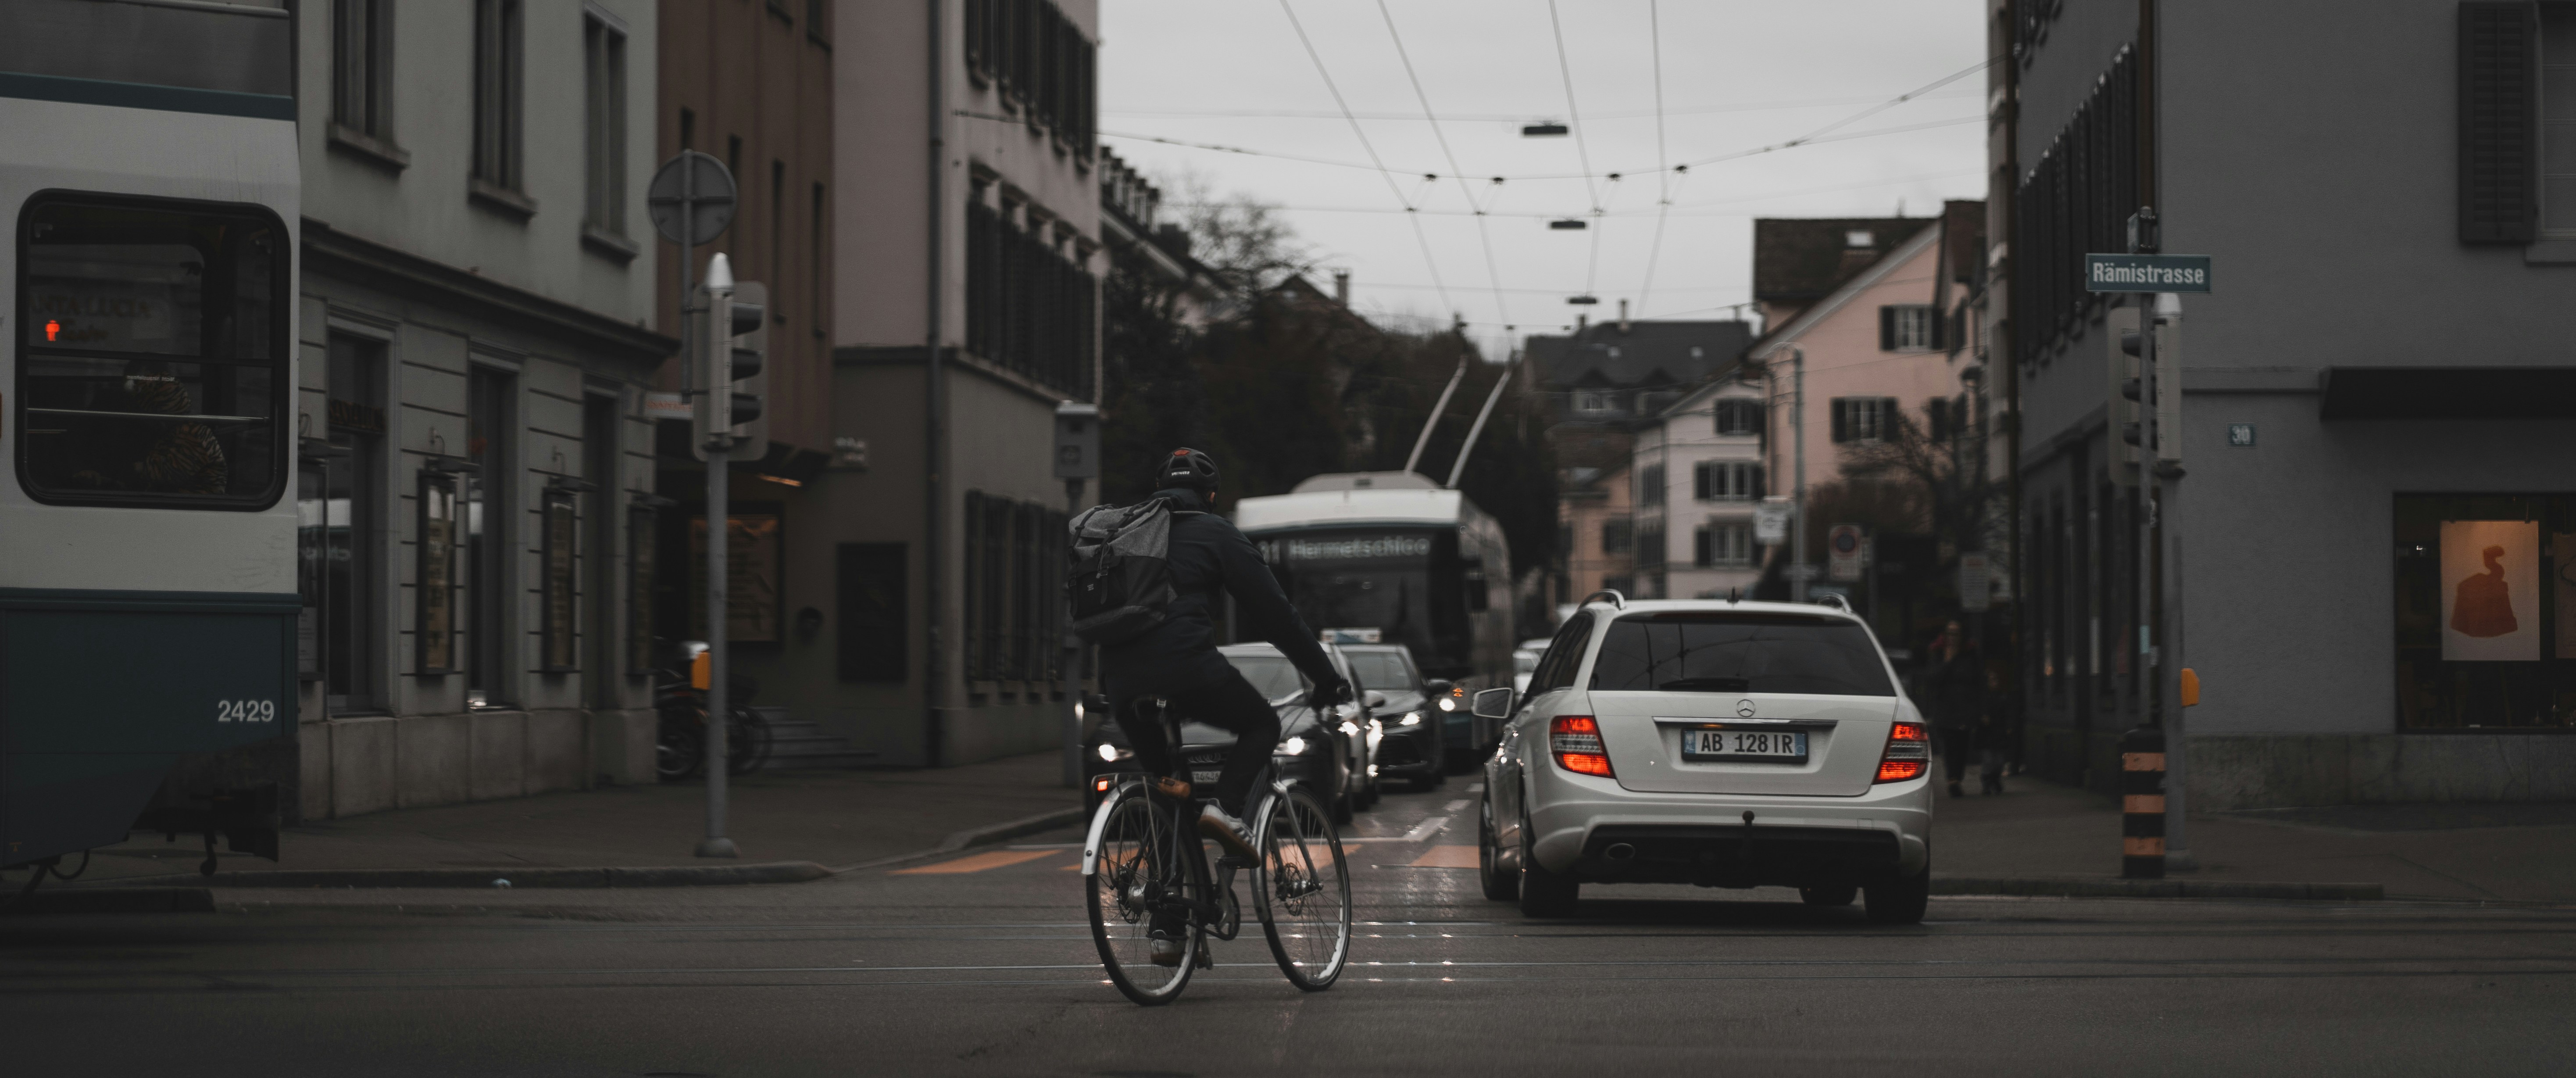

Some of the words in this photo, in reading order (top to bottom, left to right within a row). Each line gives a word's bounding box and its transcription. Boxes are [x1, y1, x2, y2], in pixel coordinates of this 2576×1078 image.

[2093, 262, 2204, 284] Rämistrasse
[2232, 426, 2251, 444] 30
[218, 700, 275, 722] 2429
[1701, 733, 1723, 752] AB
[1734, 734, 1768, 753] 128
[1773, 734, 1793, 753] IR
